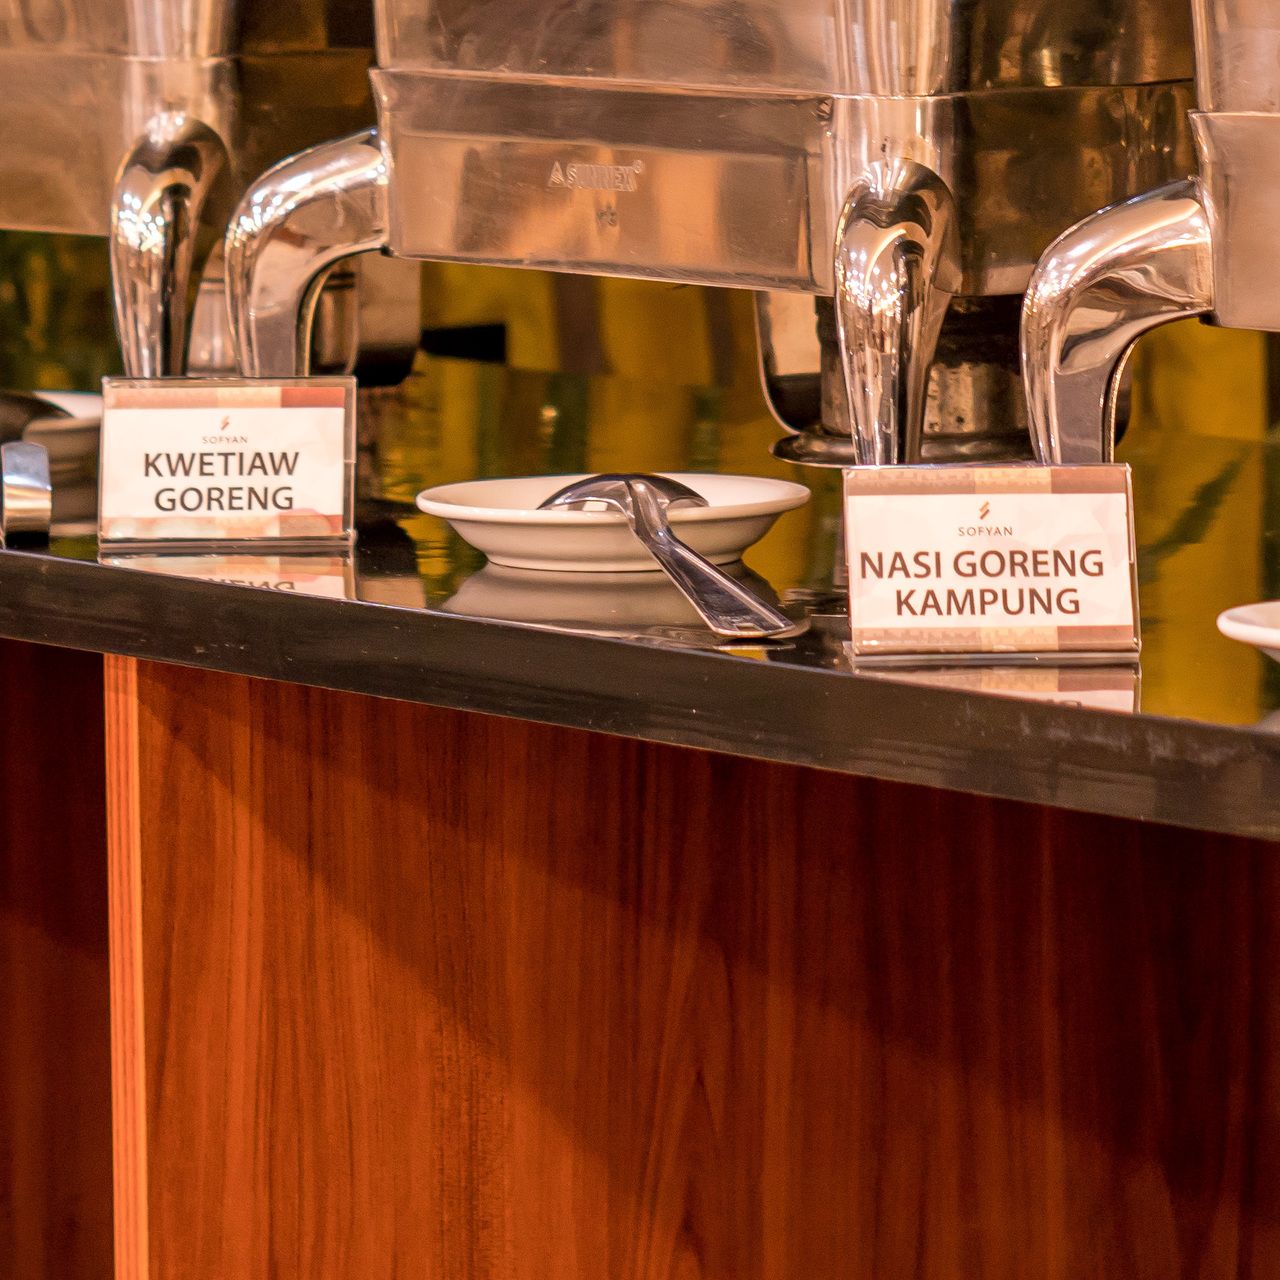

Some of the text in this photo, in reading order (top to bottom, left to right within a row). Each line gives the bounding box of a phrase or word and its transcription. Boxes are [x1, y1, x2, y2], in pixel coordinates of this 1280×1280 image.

[202, 435, 249, 445] SOFYAN
[144, 451, 300, 478] KWETIAW
[154, 486, 294, 512] GORENG
[958, 526, 1014, 537] SOFYAN
[860, 549, 1104, 580] NASI GORENG
[896, 587, 1080, 616] KAMPUNG
